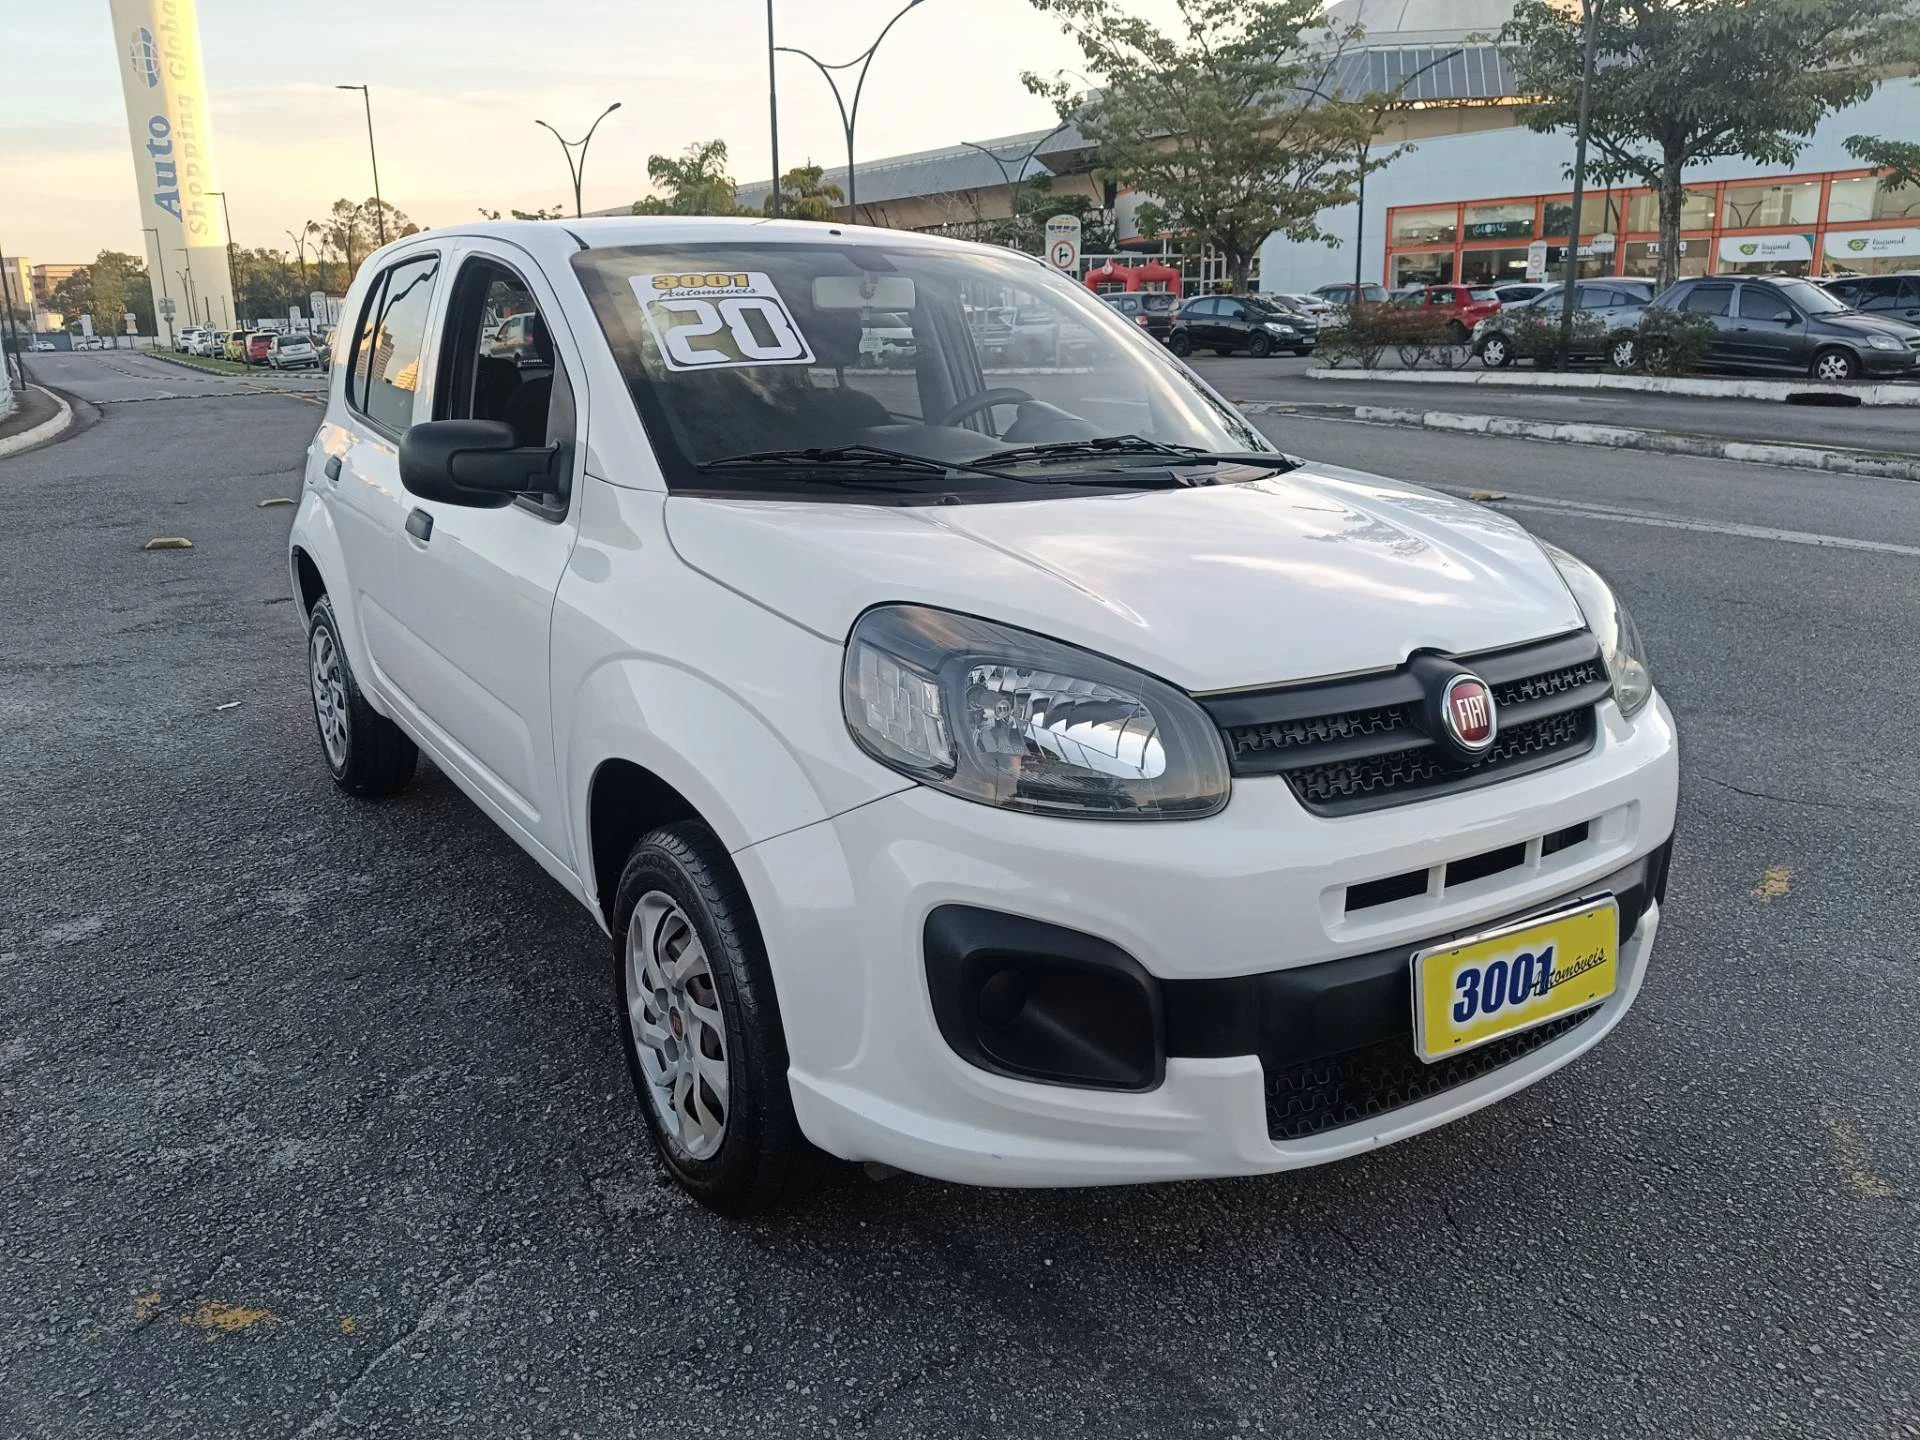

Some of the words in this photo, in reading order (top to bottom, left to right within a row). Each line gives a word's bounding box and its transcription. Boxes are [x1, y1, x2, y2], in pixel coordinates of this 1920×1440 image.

[146, 115, 183, 223] Auto
[177, 94, 208, 236] Shopping
[652, 273, 750, 290] 3001
[658, 297, 802, 365] 20
[1456, 695, 1488, 731] FIAT
[1452, 946, 1554, 1023] 3001
